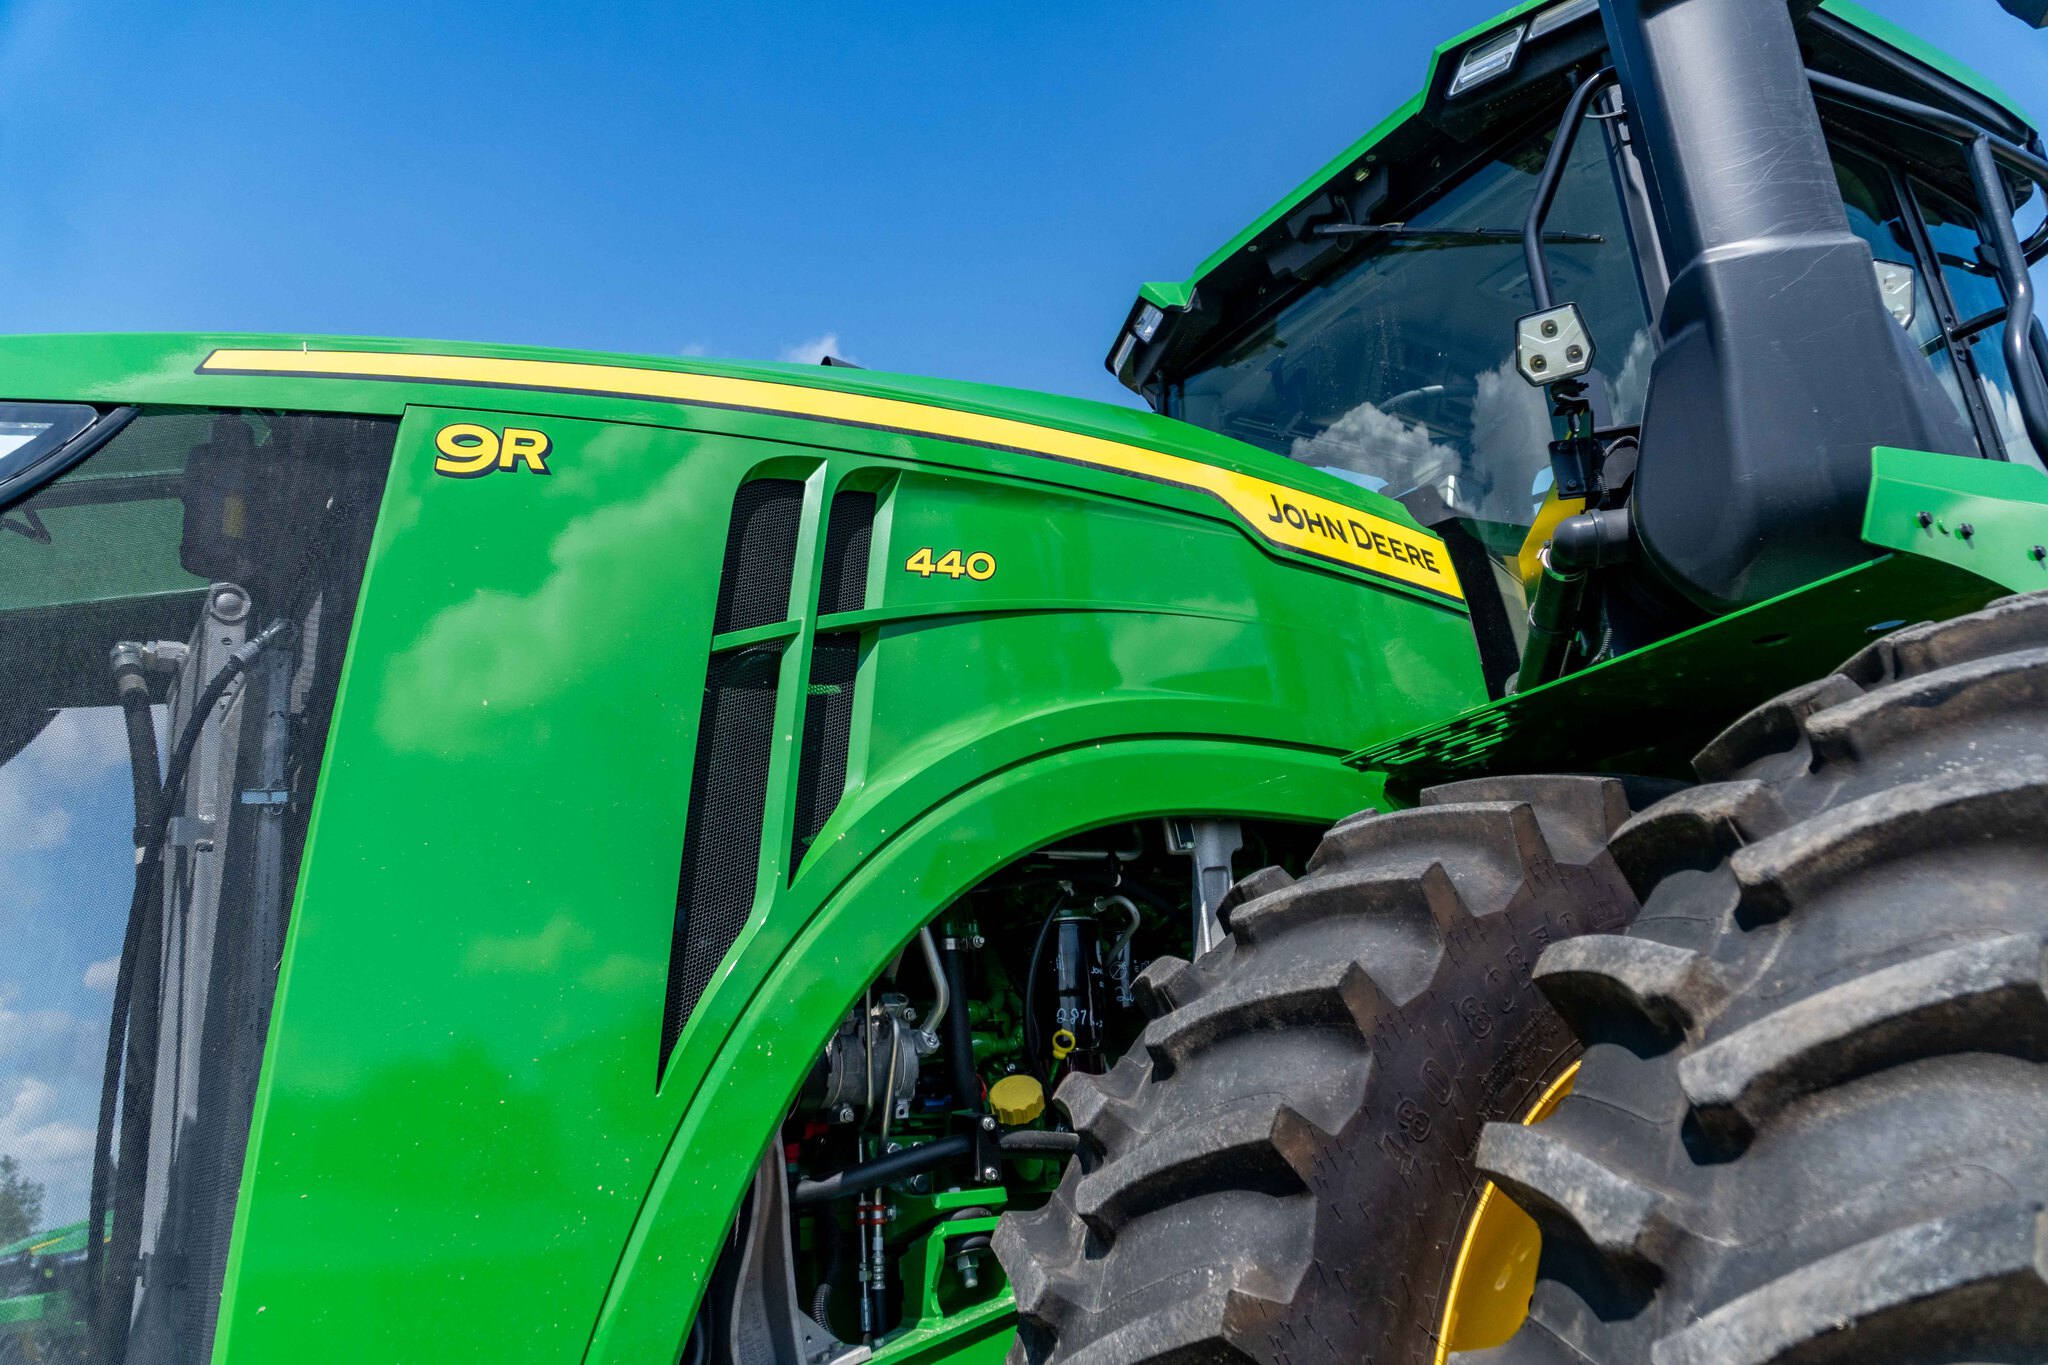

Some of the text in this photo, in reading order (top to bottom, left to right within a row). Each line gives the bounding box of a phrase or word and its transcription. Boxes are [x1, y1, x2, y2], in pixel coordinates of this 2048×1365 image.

[434, 423, 553, 479] 9R
[1267, 493, 1441, 574] JOHN DEERE
[905, 547, 996, 581] 440
[1056, 1007, 1087, 1026] 287
